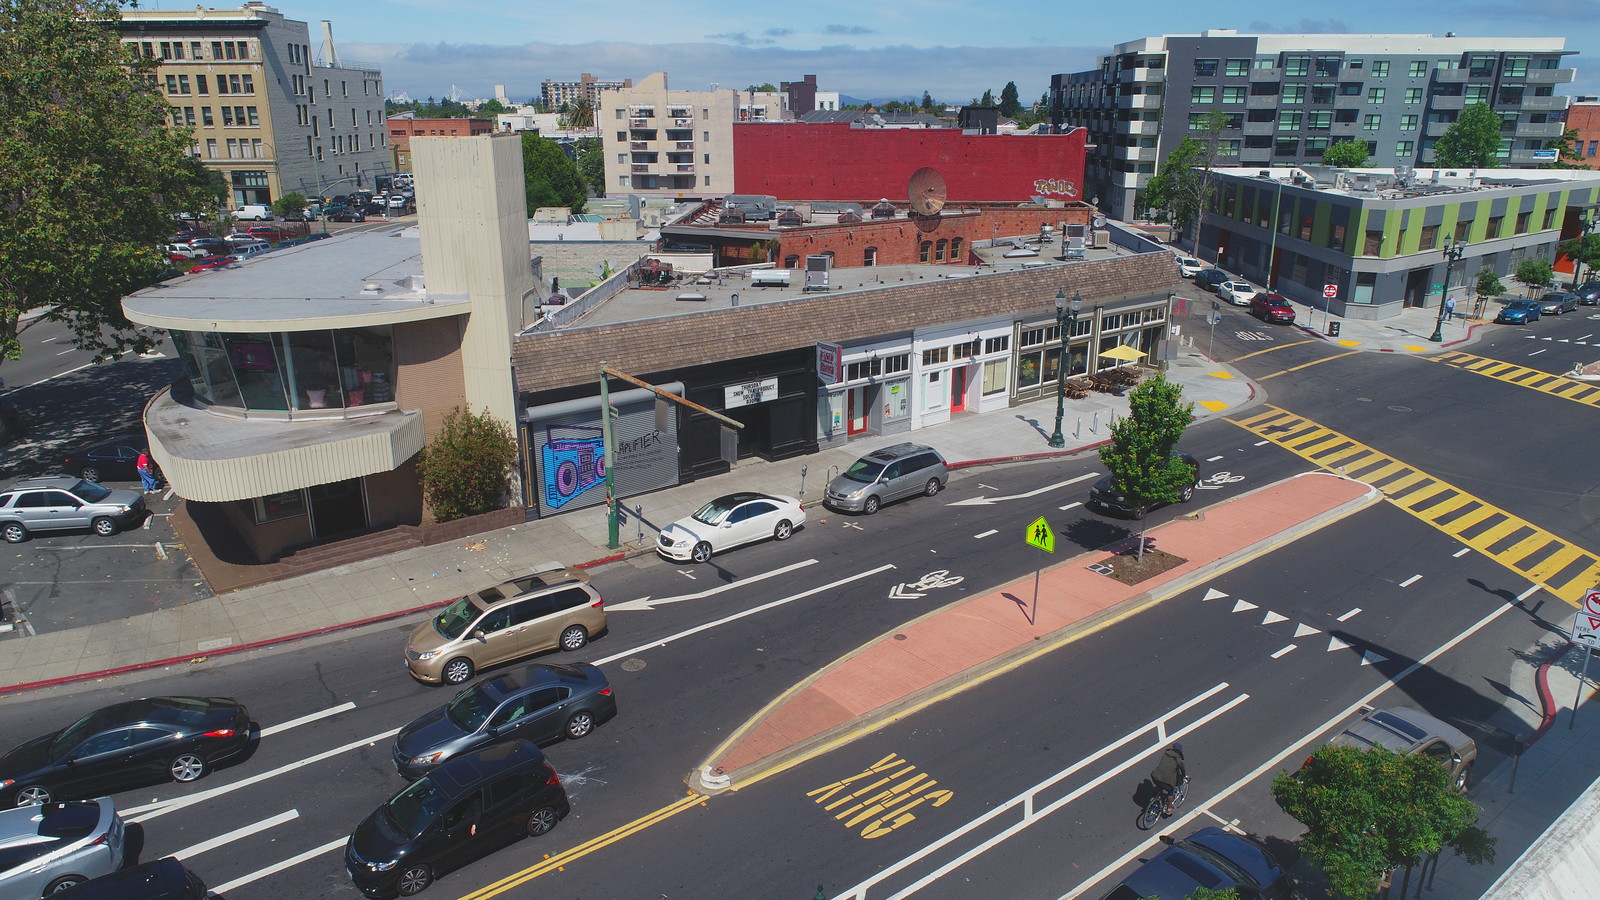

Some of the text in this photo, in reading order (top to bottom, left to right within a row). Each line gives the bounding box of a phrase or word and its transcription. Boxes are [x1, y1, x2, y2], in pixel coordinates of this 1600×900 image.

[1235, 331, 1274, 341] STOP
[617, 429, 662, 454] MPLIFIER
[1575, 625, 1591, 633] HERE
[806, 752, 954, 839] XING
